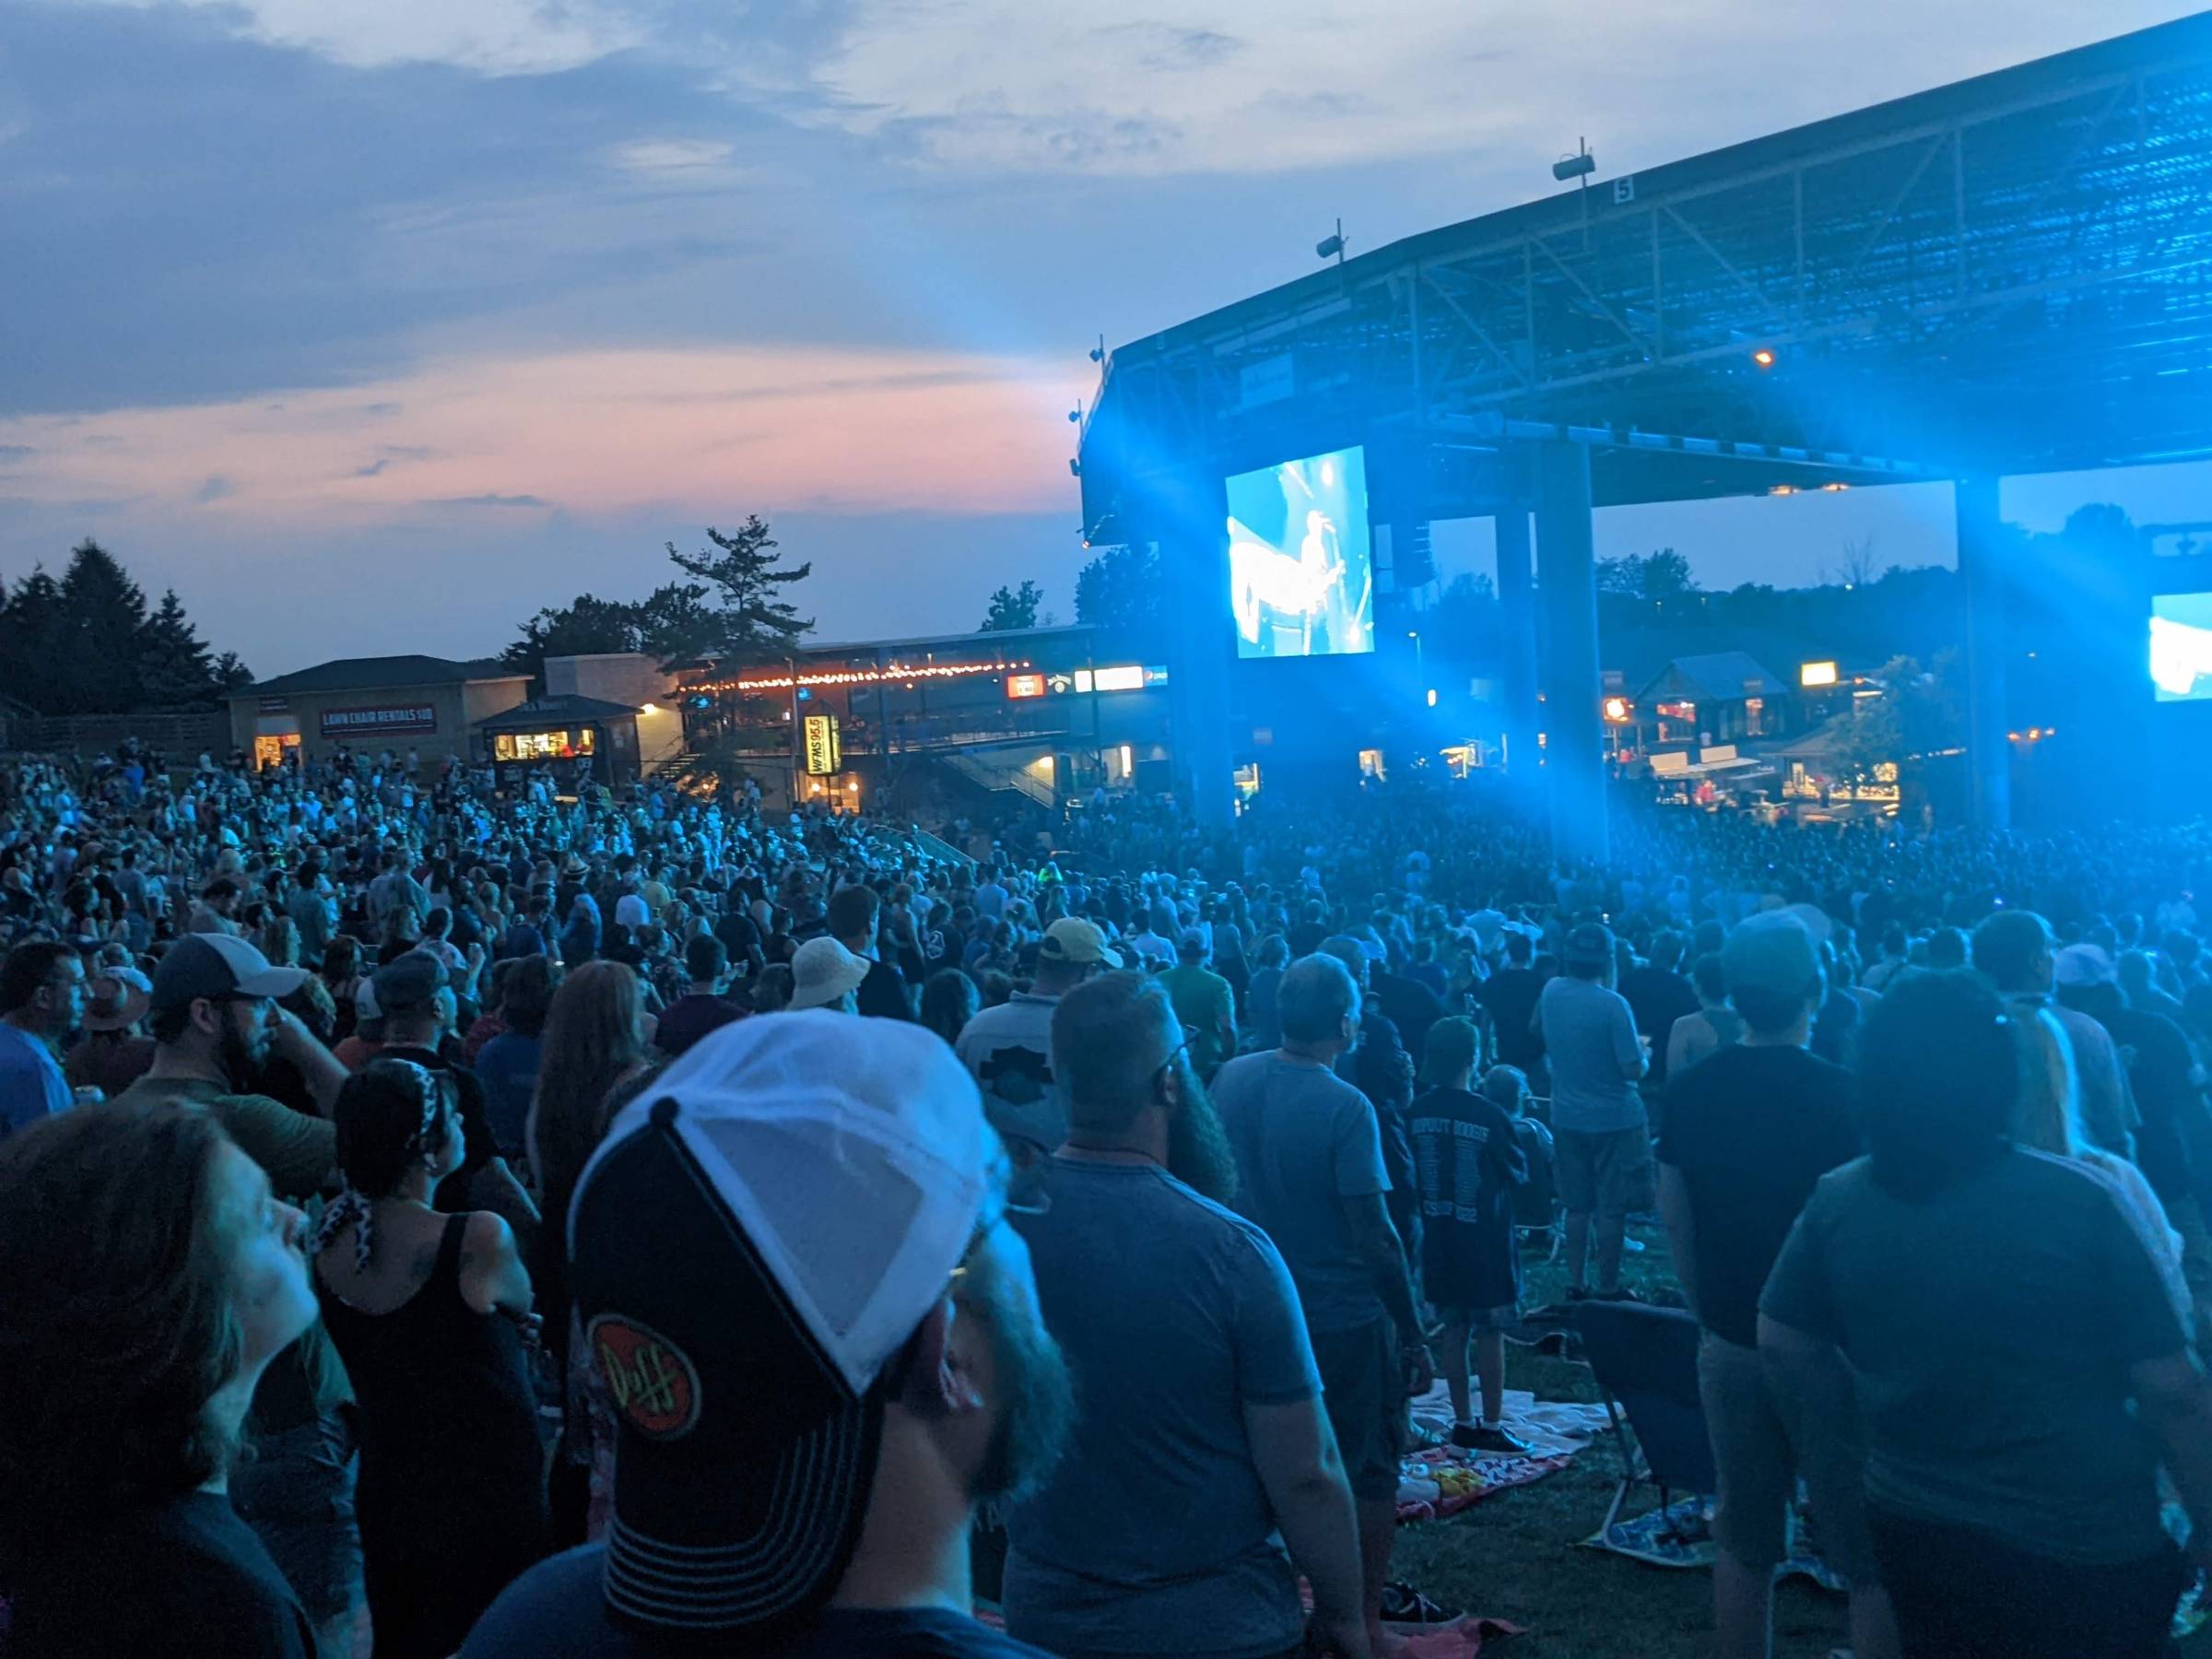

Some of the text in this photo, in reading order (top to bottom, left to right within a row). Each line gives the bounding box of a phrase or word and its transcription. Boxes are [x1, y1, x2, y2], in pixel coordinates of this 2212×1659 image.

[1618, 179, 1630, 199] 5
[377, 709, 416, 723] RENTALS
[809, 718, 823, 772] WFMS 95.5
[598, 1342, 680, 1414] Duff
